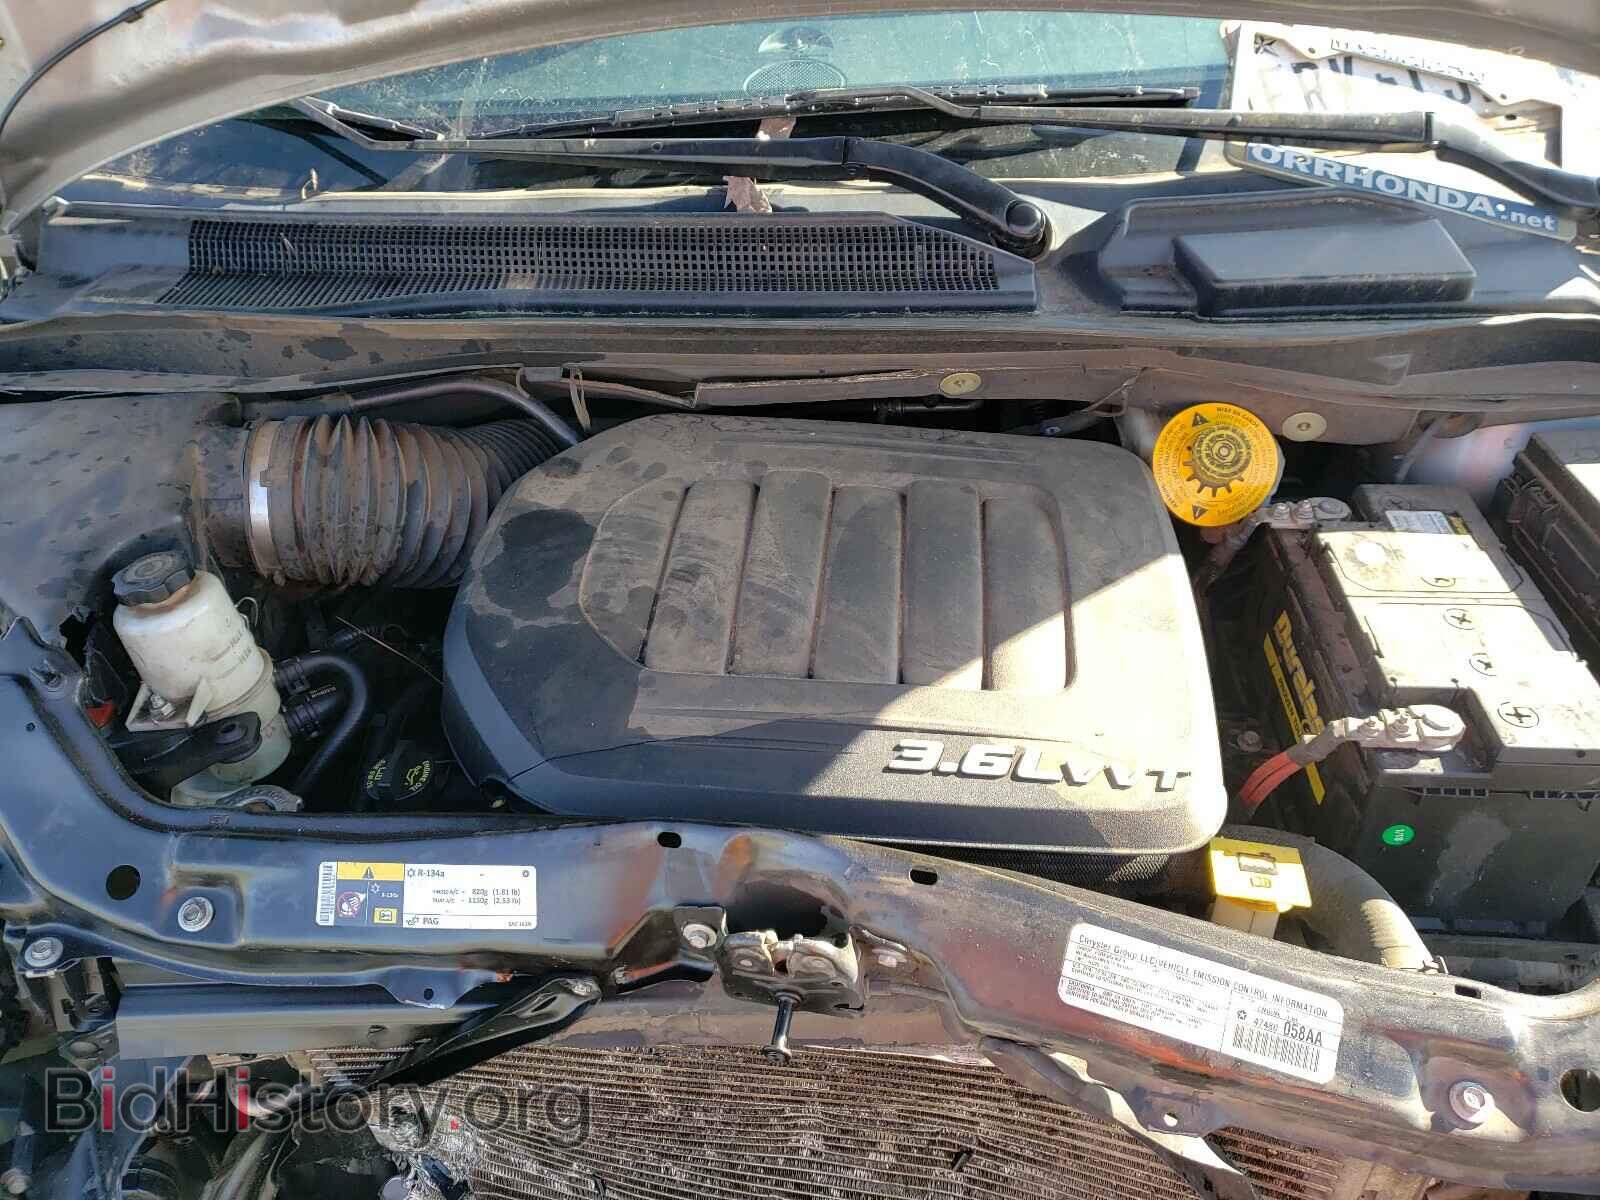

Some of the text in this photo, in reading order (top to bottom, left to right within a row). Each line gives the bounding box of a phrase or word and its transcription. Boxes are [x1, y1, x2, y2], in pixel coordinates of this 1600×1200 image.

[417, 869, 445, 879] R-134a
[422, 917, 440, 926] PAG
[1079, 934, 1112, 951] Chrysler
[1114, 945, 1138, 961] Group
[1193, 969, 1231, 988] EMISSION
[1233, 983, 1269, 1001] CONTROL
[1272, 993, 1328, 1018] INFORMATION
[1283, 1020, 1322, 1047] 058AA
